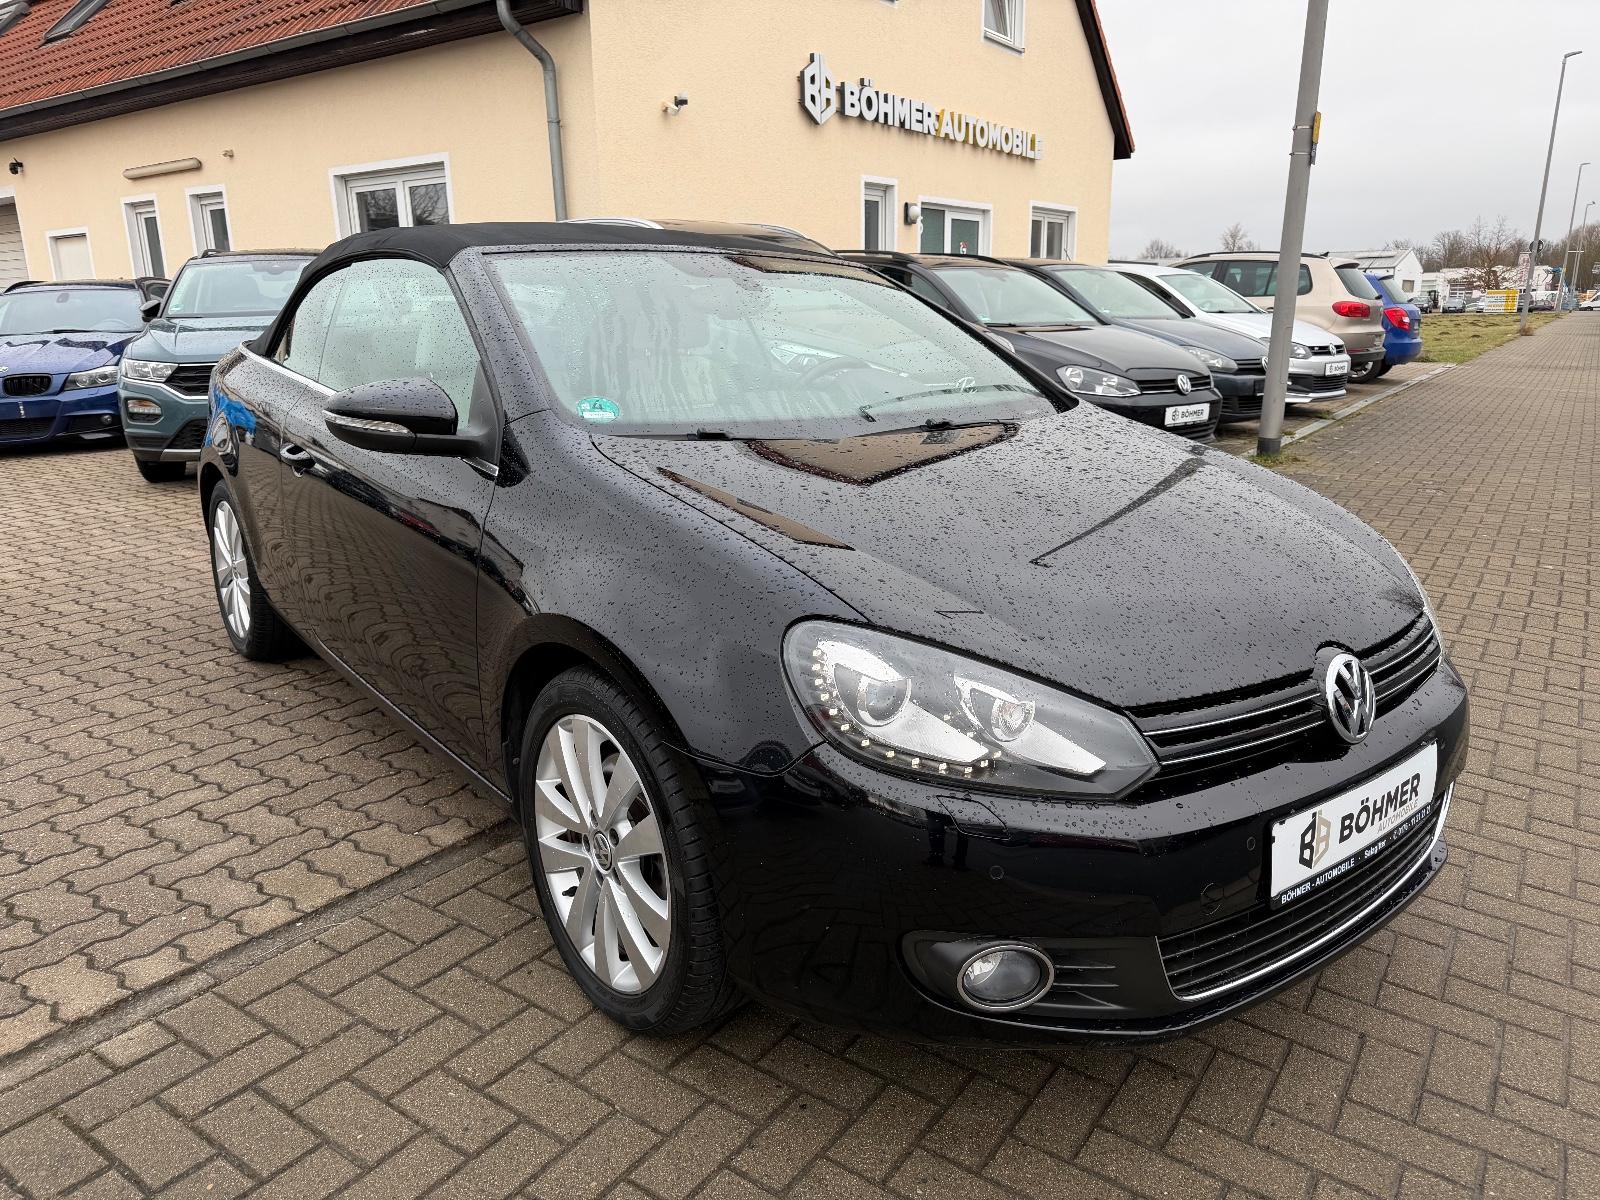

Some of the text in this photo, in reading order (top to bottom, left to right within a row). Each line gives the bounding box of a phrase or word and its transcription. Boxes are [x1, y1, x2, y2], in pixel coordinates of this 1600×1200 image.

[841, 77, 1042, 160] BÖHMER AUTOMOBILE
[1181, 408, 1204, 419] BÖHMER
[1326, 653, 1376, 743] VW
[1339, 773, 1420, 844] BÖHMER
[1377, 798, 1419, 833] AUTOMOBILE
[1281, 882, 1312, 904] BÖHMER
[1315, 858, 1355, 887] AUTOMOBILE
